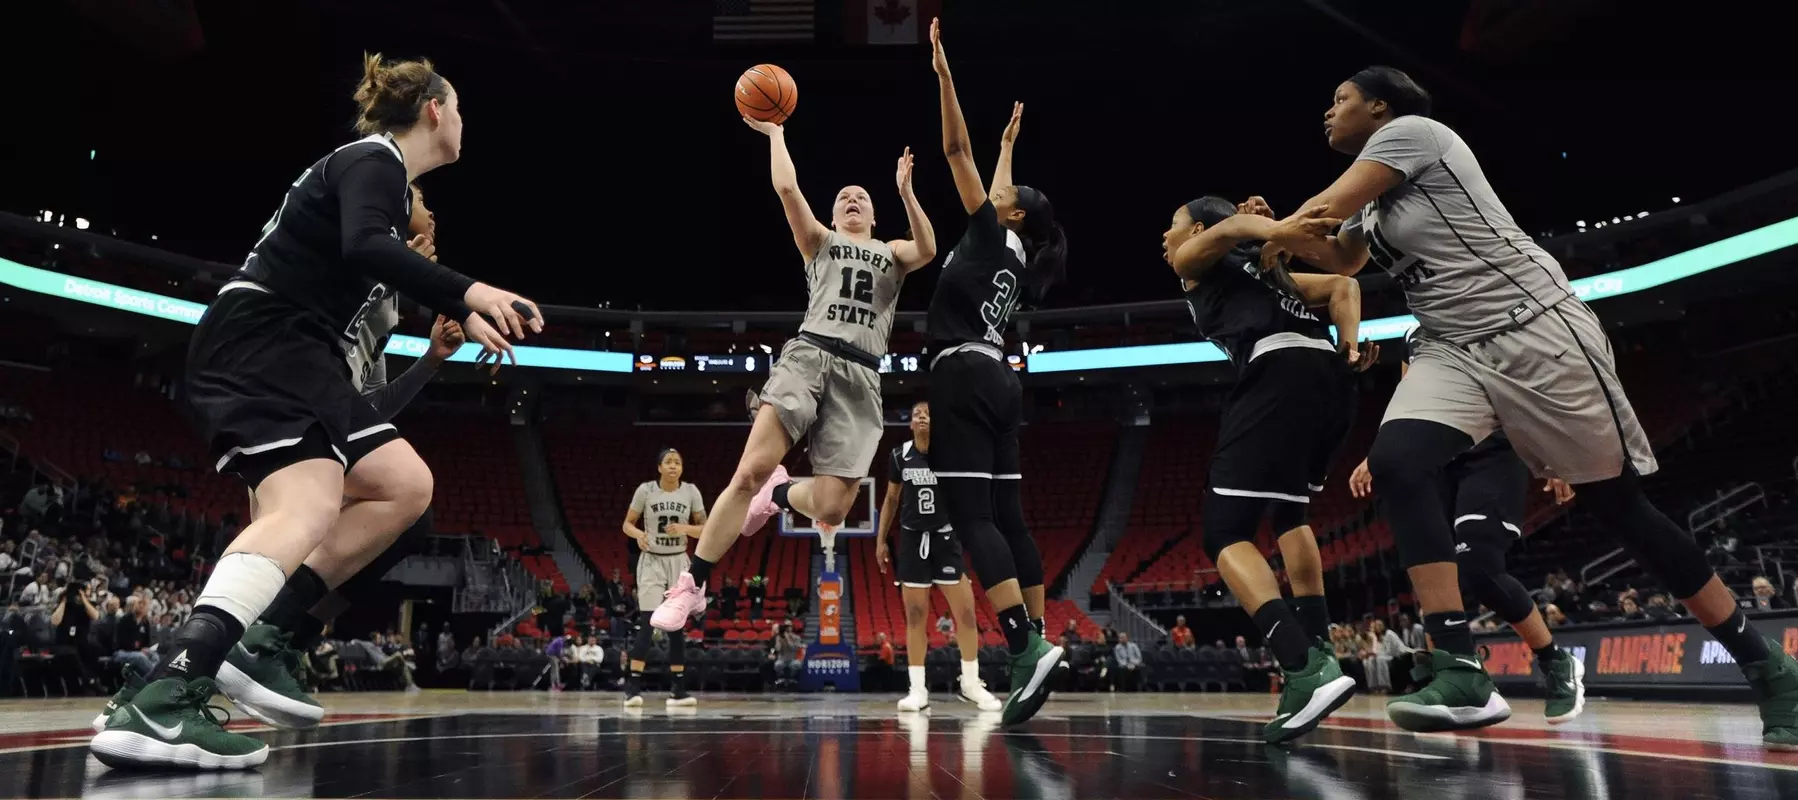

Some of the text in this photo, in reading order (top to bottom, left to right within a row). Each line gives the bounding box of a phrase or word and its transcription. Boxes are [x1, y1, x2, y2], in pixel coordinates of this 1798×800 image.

[829, 245, 893, 274] WRIGHT
[64, 278, 111, 301] Detroit
[113, 289, 155, 312] Sports
[839, 266, 874, 304] 12
[827, 304, 877, 330] STATE
[745, 356, 755, 372] 8
[900, 356, 918, 372] 13
[650, 501, 688, 514] WRIGHT
[918, 488, 935, 514] 2
[655, 536, 681, 547] STATE
[807, 659, 850, 669] HORIZON
[1596, 632, 1687, 675] RAMPAGE
